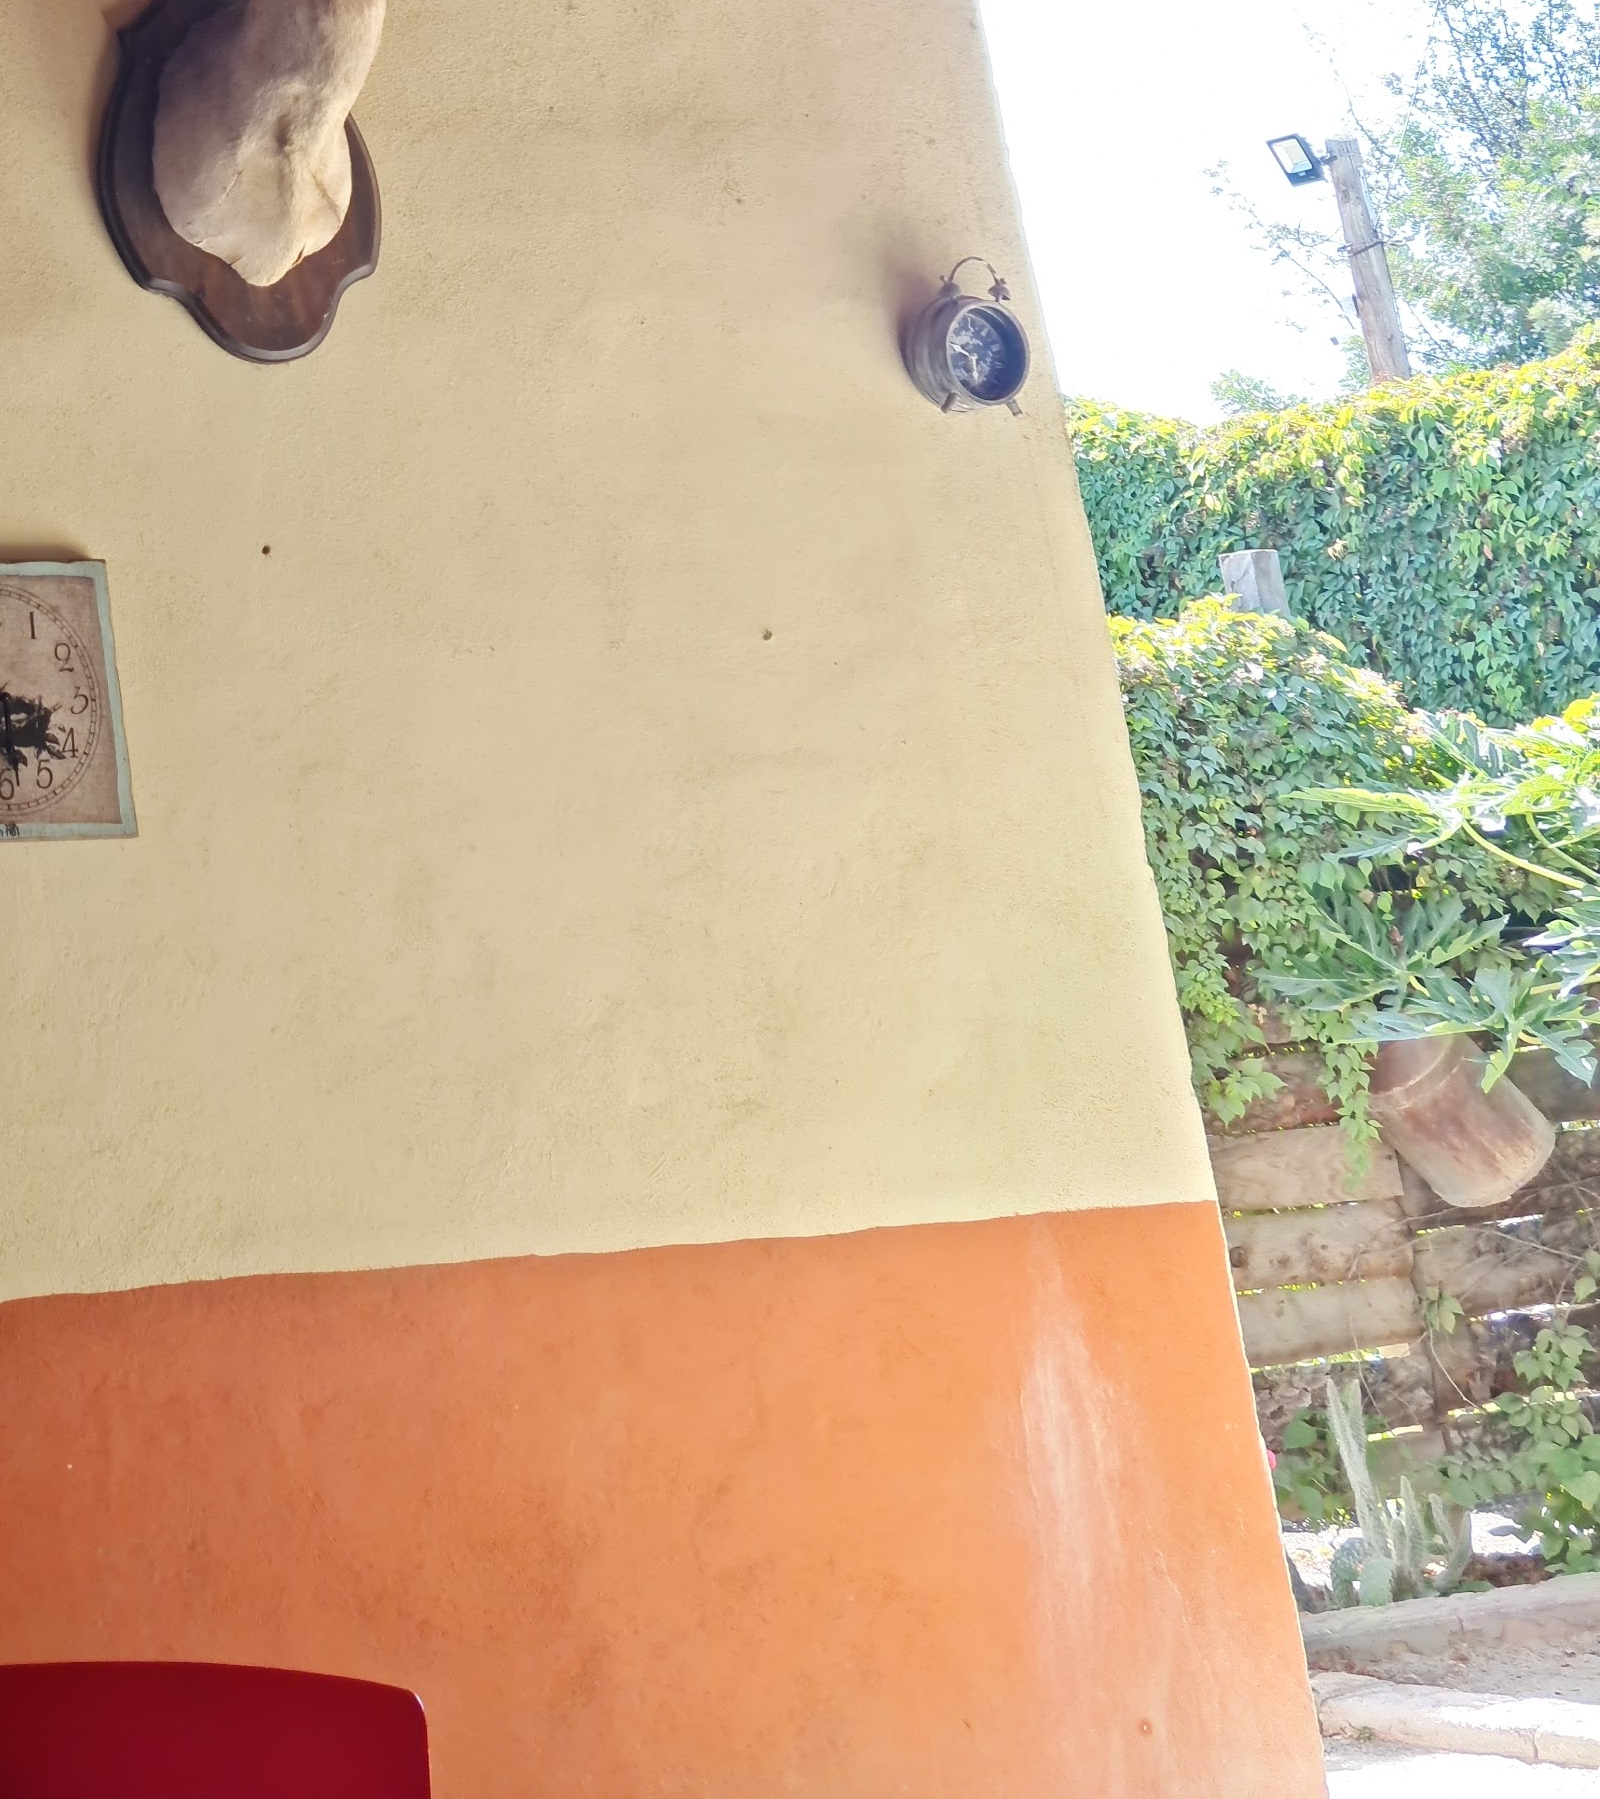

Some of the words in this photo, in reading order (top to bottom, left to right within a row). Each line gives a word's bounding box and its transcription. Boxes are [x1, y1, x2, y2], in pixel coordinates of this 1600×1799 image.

[29, 611, 37, 640] 1
[53, 642, 75, 673] 2
[69, 686, 89, 715] 3
[61, 727, 79, 758] 4
[35, 758, 54, 789] 5
